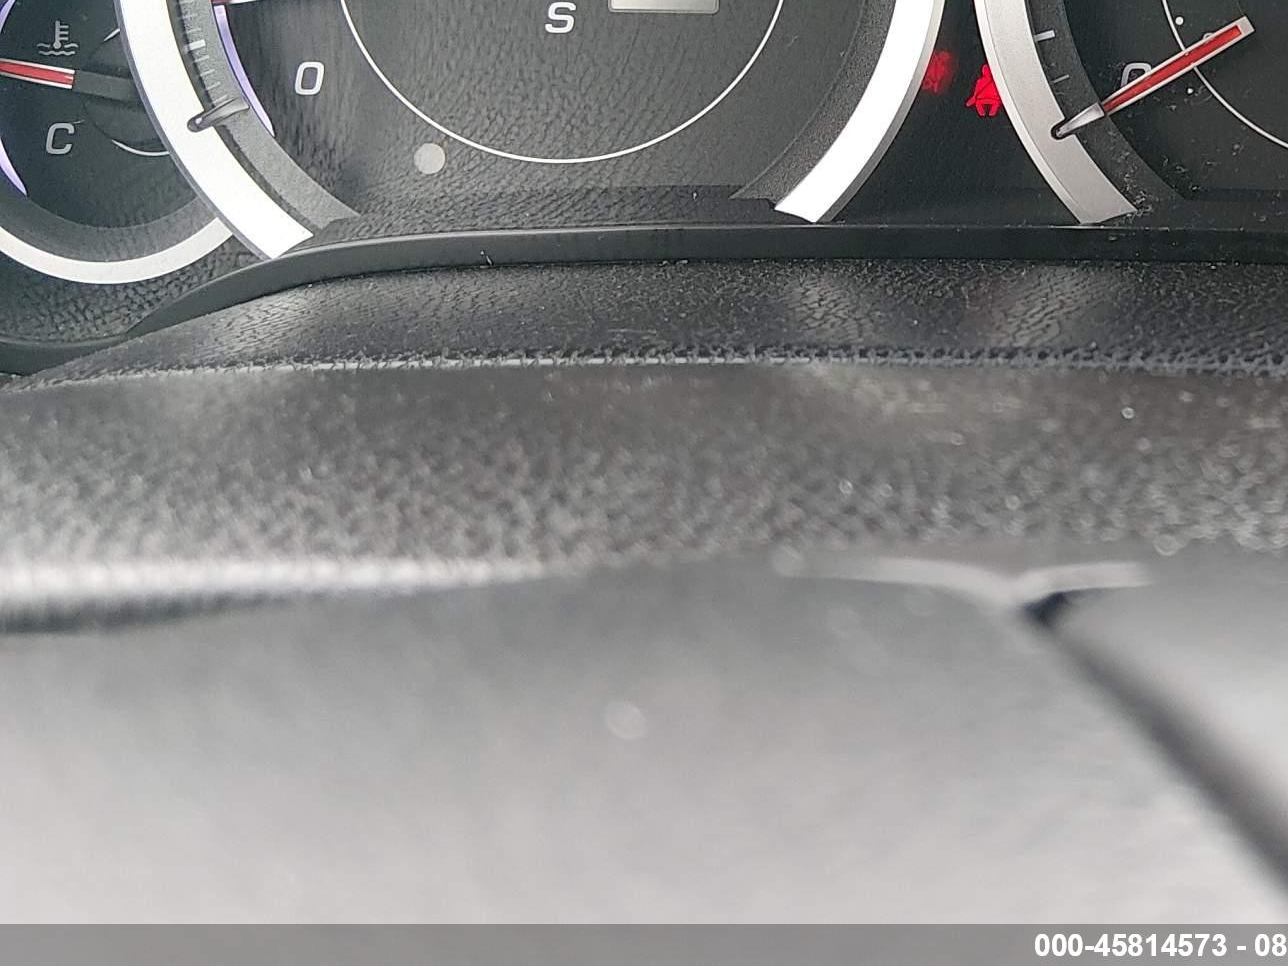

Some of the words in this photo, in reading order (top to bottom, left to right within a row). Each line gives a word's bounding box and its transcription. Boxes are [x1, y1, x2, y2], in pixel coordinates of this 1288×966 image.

[544, 1, 577, 34] S
[294, 61, 325, 96] 0
[45, 122, 75, 155] C
